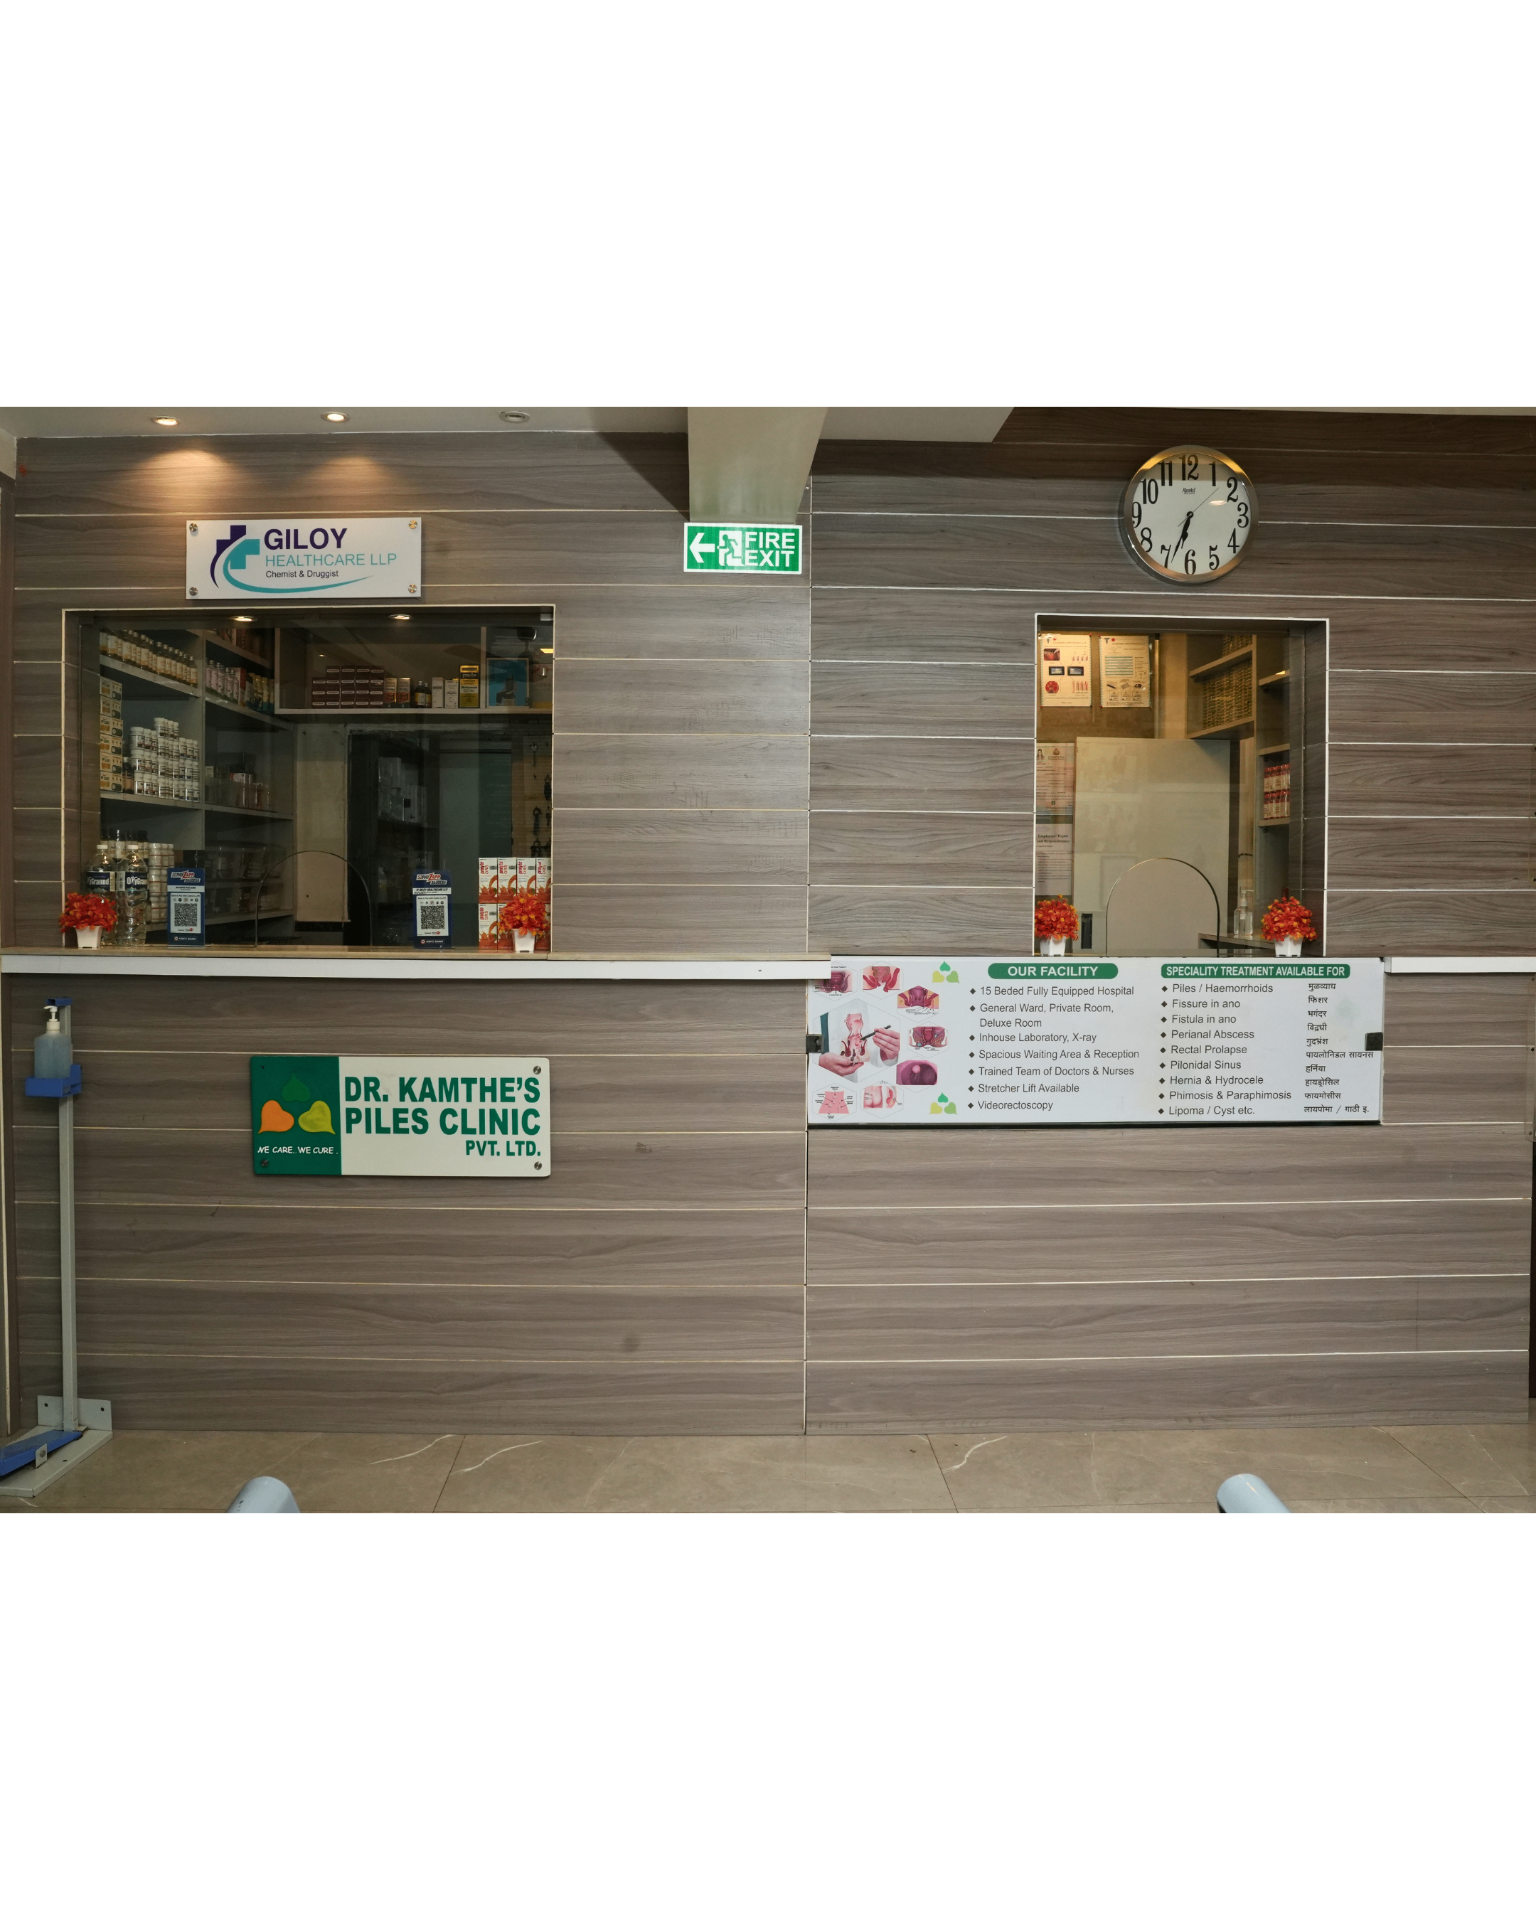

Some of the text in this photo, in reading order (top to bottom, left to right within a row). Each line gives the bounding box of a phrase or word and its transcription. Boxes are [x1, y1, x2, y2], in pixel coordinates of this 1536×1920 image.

[1179, 454, 1199, 481] 12
[1158, 461, 1173, 486] 11
[1209, 461, 1217, 487] 1
[1141, 478, 1159, 504] 10
[1226, 476, 1239, 503] 2
[1132, 501, 1142, 528] 9
[1237, 502, 1249, 528] 3
[264, 528, 347, 551] GILOY
[745, 532, 795, 549] FIRE
[1140, 527, 1153, 553] 8
[1227, 528, 1240, 553] 4
[266, 553, 396, 566] HEALTHCARE LLP
[745, 550, 794, 567] EXIT
[1160, 544, 1172, 569] 7
[1209, 545, 1220, 570] 5
[1184, 549, 1197, 575] 6
[266, 570, 297, 578] Chemist
[307, 570, 338, 578] Druggist
[1008, 966, 1098, 976] OUR FACILITY
[1167, 966, 1345, 976] SPECIALITY TREATMENT AVAILABLE FOR
[981, 986, 1134, 997] 15 Beded Fully Equipped Hospital
[1173, 984, 1196, 992] Piles
[1206, 984, 1273, 992] Haemorrhoids
[1173, 1000, 1207, 1008] Fissure
[1211, 1000, 1219, 1008] in
[1308, 995, 1328, 1004] फिशर
[980, 1003, 1113, 1013] General Ward, Private Room,
[1308, 1009, 1327, 1018] भगंदर
[980, 1018, 1041, 1027] Deluxe Room
[1172, 1015, 1203, 1023] Fistula
[1207, 1015, 1215, 1023] in
[980, 1033, 1096, 1043] Inhouse Laboratory, X-ray
[1172, 1030, 1254, 1038] Perianal Abscess
[979, 1050, 1139, 1060] Spacious Waiting Area & Reception
[1171, 1045, 1247, 1055] Rectal Prolapse
[1171, 1060, 1241, 1069] Pilonidal Sinus
[979, 1067, 1134, 1075] Trained Team of Doctors & Nurses
[1170, 1076, 1263, 1086] Hernia & Hydrocele
[345, 1077, 388, 1102] DR.
[978, 1084, 1079, 1092] Stretcher Lift Available
[1170, 1091, 1291, 1101] Phimosis & Paraphimosis
[978, 1101, 1053, 1111] Videorectoscopy
[1169, 1106, 1204, 1116] Lipoma
[1214, 1106, 1235, 1116] Cyst
[1238, 1106, 1254, 1114] etc.
[346, 1108, 540, 1135] PILES CLINIC
[298, 1146, 311, 1155] WE
[466, 1140, 540, 1156] PVT. LTD.
